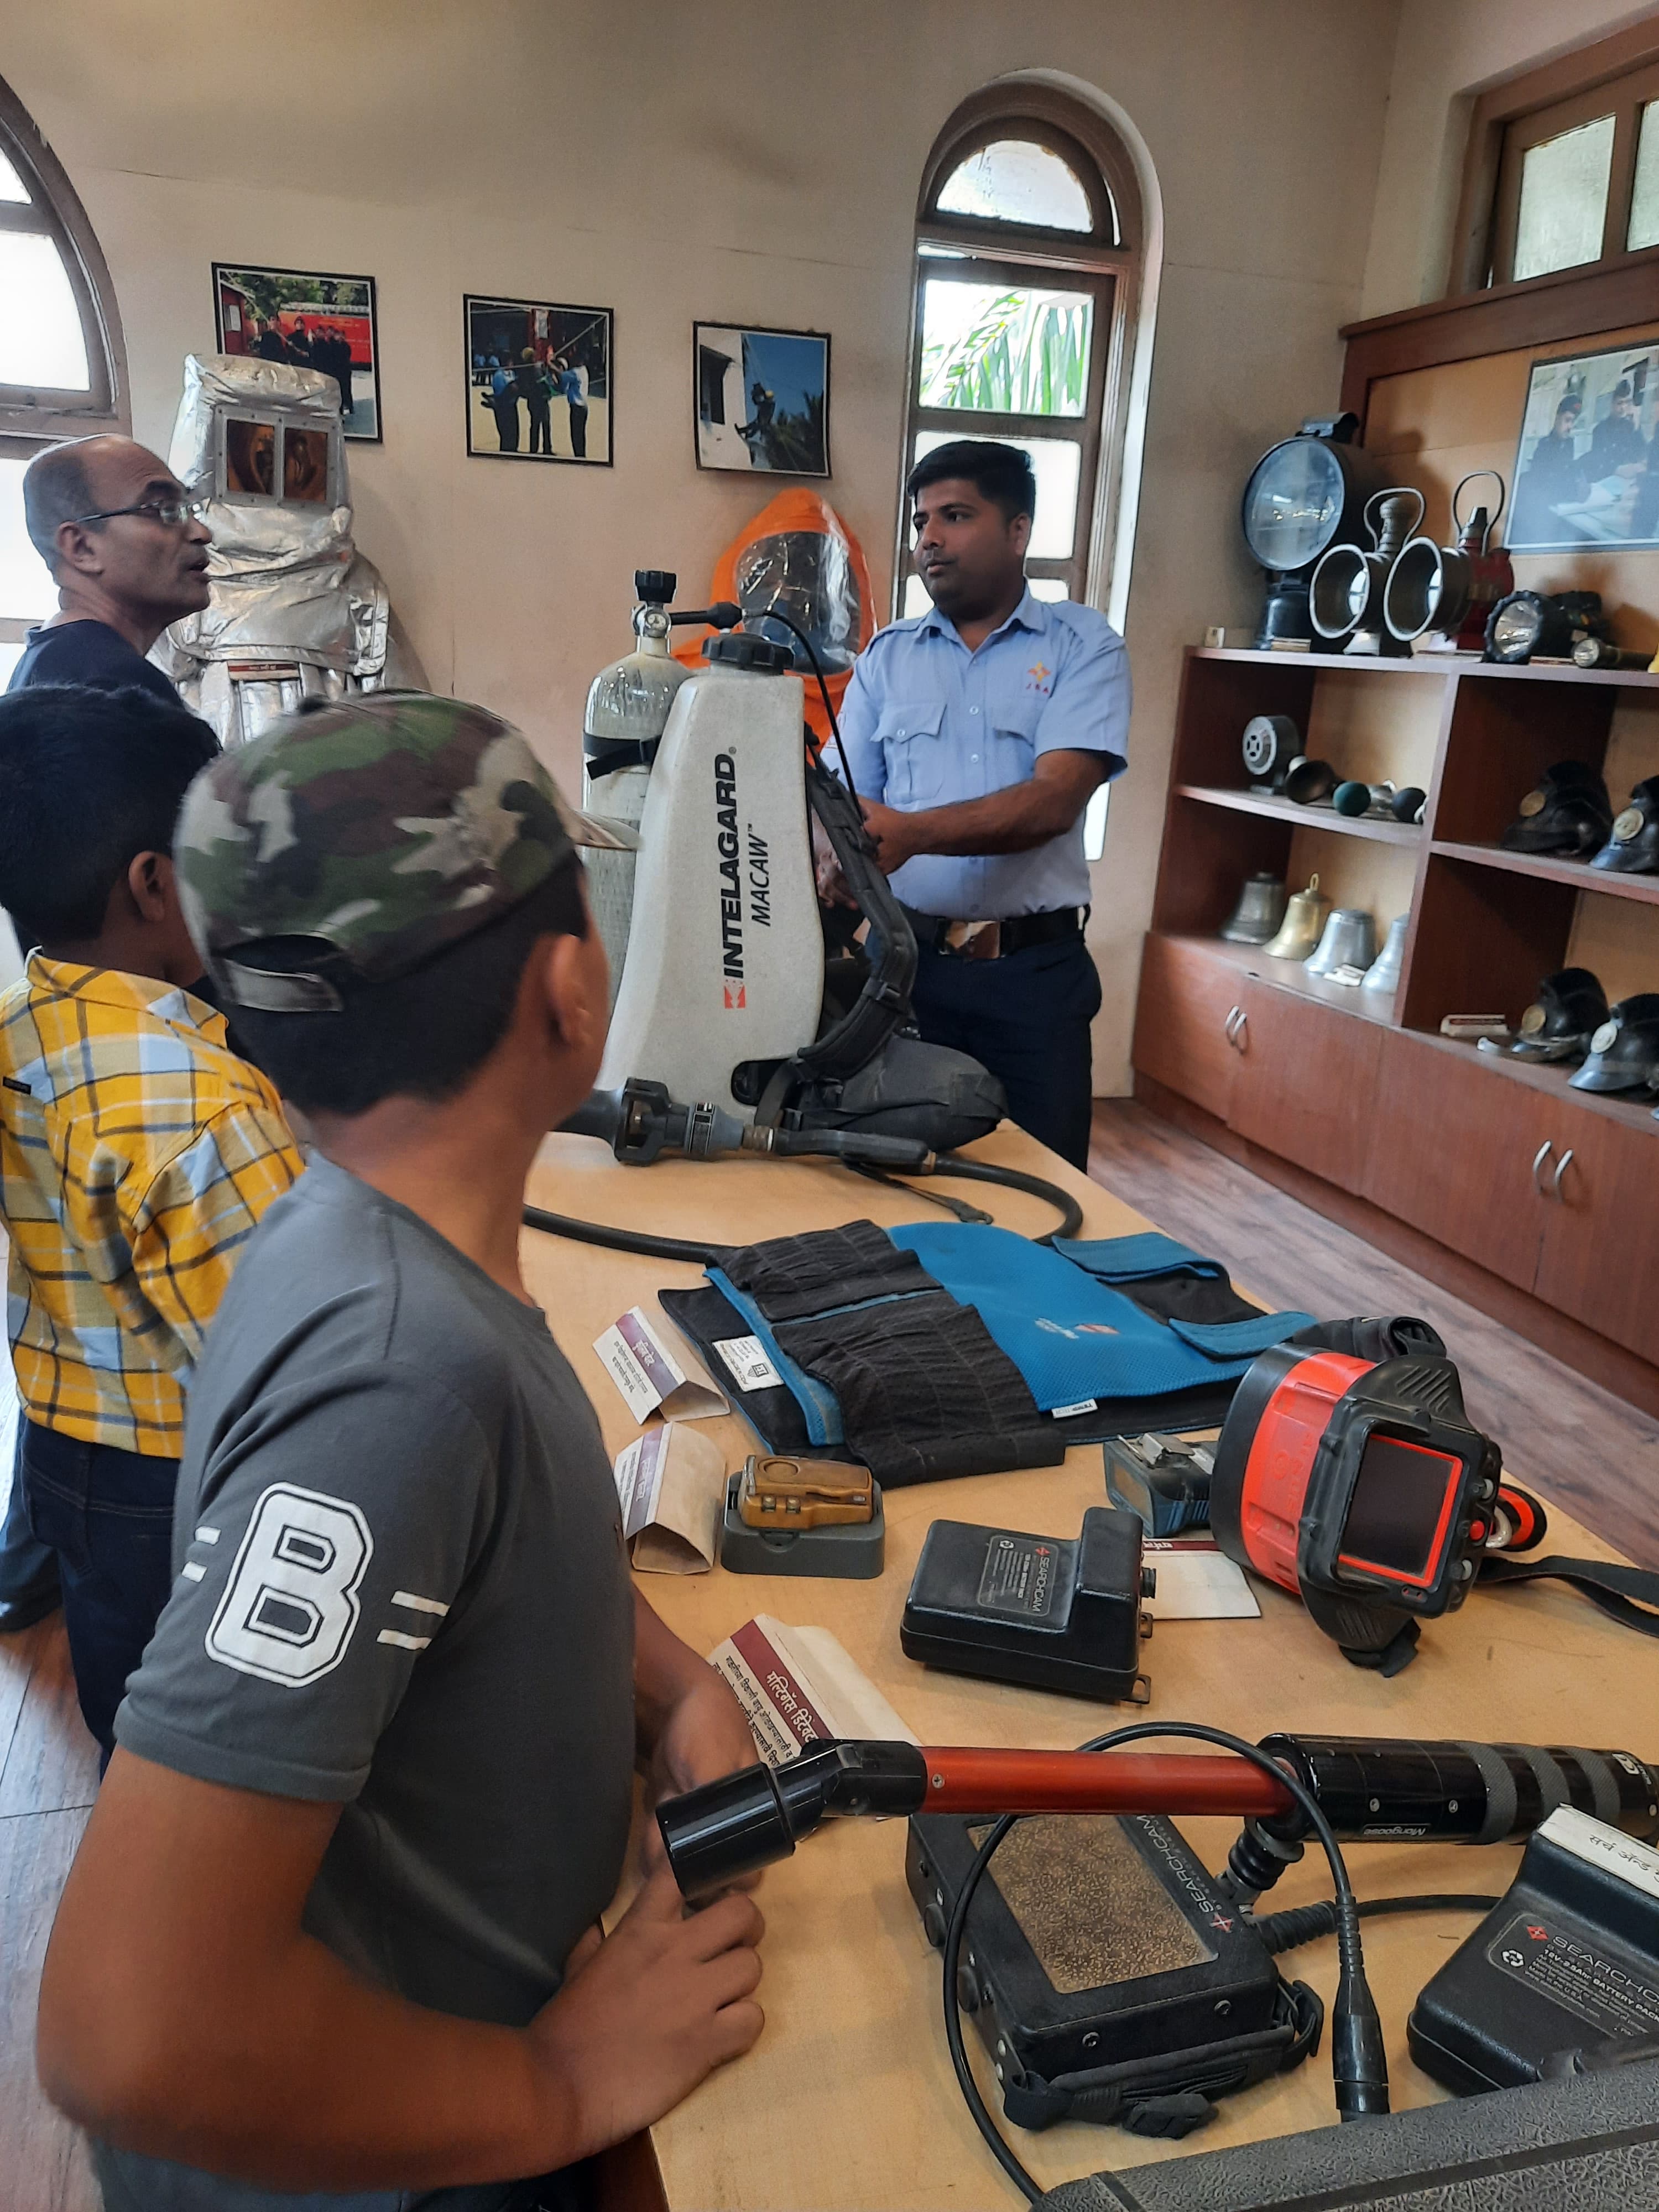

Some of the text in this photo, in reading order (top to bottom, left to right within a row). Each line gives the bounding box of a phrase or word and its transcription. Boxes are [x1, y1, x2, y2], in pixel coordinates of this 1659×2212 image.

[748, 833, 771, 927] MACAW
[204, 1480, 374, 1689] B
[1032, 1557, 1050, 1611] SEARCHCAM
[1136, 1815, 1214, 1912] SEARCHCAM
[1553, 1936, 1659, 2005] SEARCHC
[1593, 1978, 1635, 2005] BATTERY
